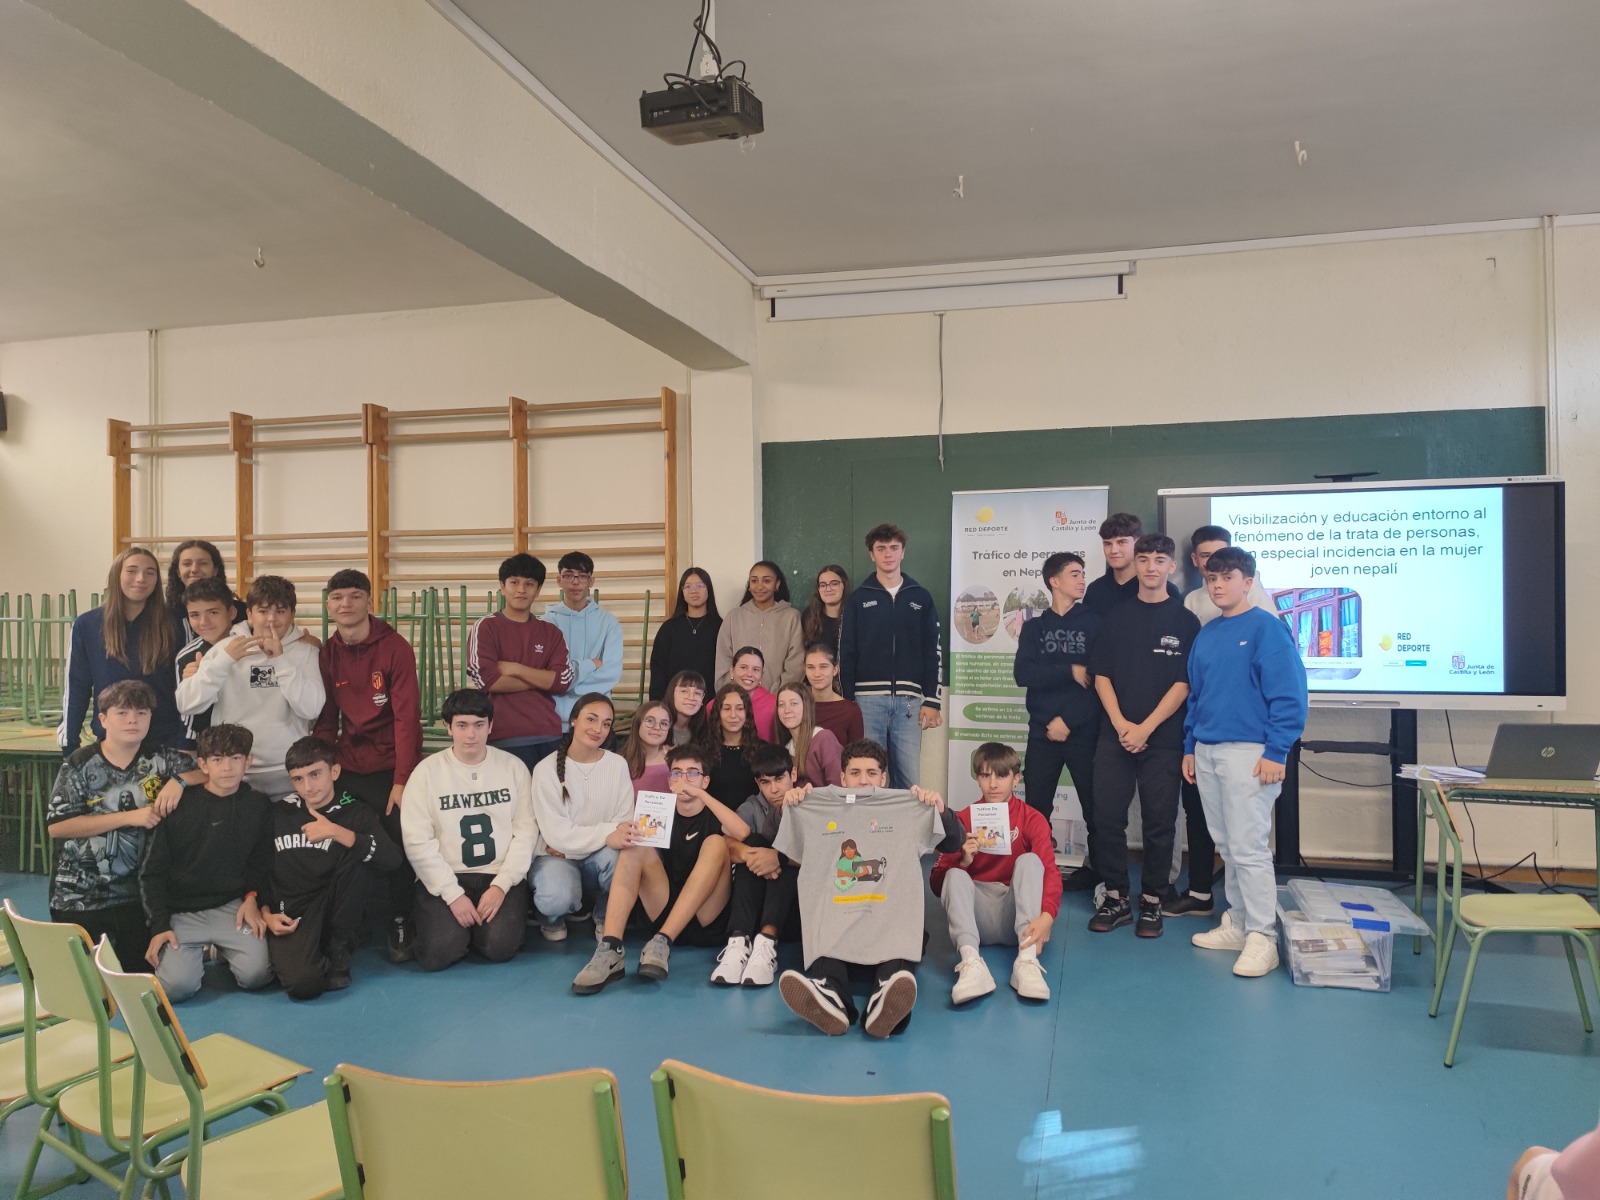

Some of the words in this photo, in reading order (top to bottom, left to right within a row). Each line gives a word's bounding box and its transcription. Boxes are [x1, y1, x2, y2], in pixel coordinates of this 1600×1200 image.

[1228, 512, 1317, 525] Visibilización
[1320, 514, 1329, 526] y
[1333, 510, 1408, 523] educación
[1412, 509, 1470, 520] entorno
[1473, 507, 1487, 519] al
[1234, 530, 1304, 542] fenómeno
[1307, 529, 1325, 541] de
[1329, 529, 1341, 540] la
[1346, 529, 1379, 540] trata
[1383, 527, 1402, 539] de
[1406, 528, 1480, 541] personas,
[972, 549, 1010, 560] Tráfico
[1013, 549, 1028, 559] de
[1031, 550, 1086, 561] peras
[1260, 547, 1319, 561] especial
[1323, 545, 1396, 558] incidencia
[1399, 547, 1418, 556] en
[1422, 544, 1435, 556] la
[1440, 544, 1484, 558] mujer
[1002, 568, 1017, 577] en
[1019, 567, 1043, 579] Nep
[1310, 564, 1349, 578] joven
[1353, 562, 1398, 577] nepalí
[1040, 629, 1085, 642] ACK&
[1397, 632, 1412, 641] RED
[1040, 641, 1085, 654] ONES
[1397, 644, 1431, 652] DEPORTE
[439, 788, 512, 811] HAWKINS
[460, 812, 496, 868] 8
